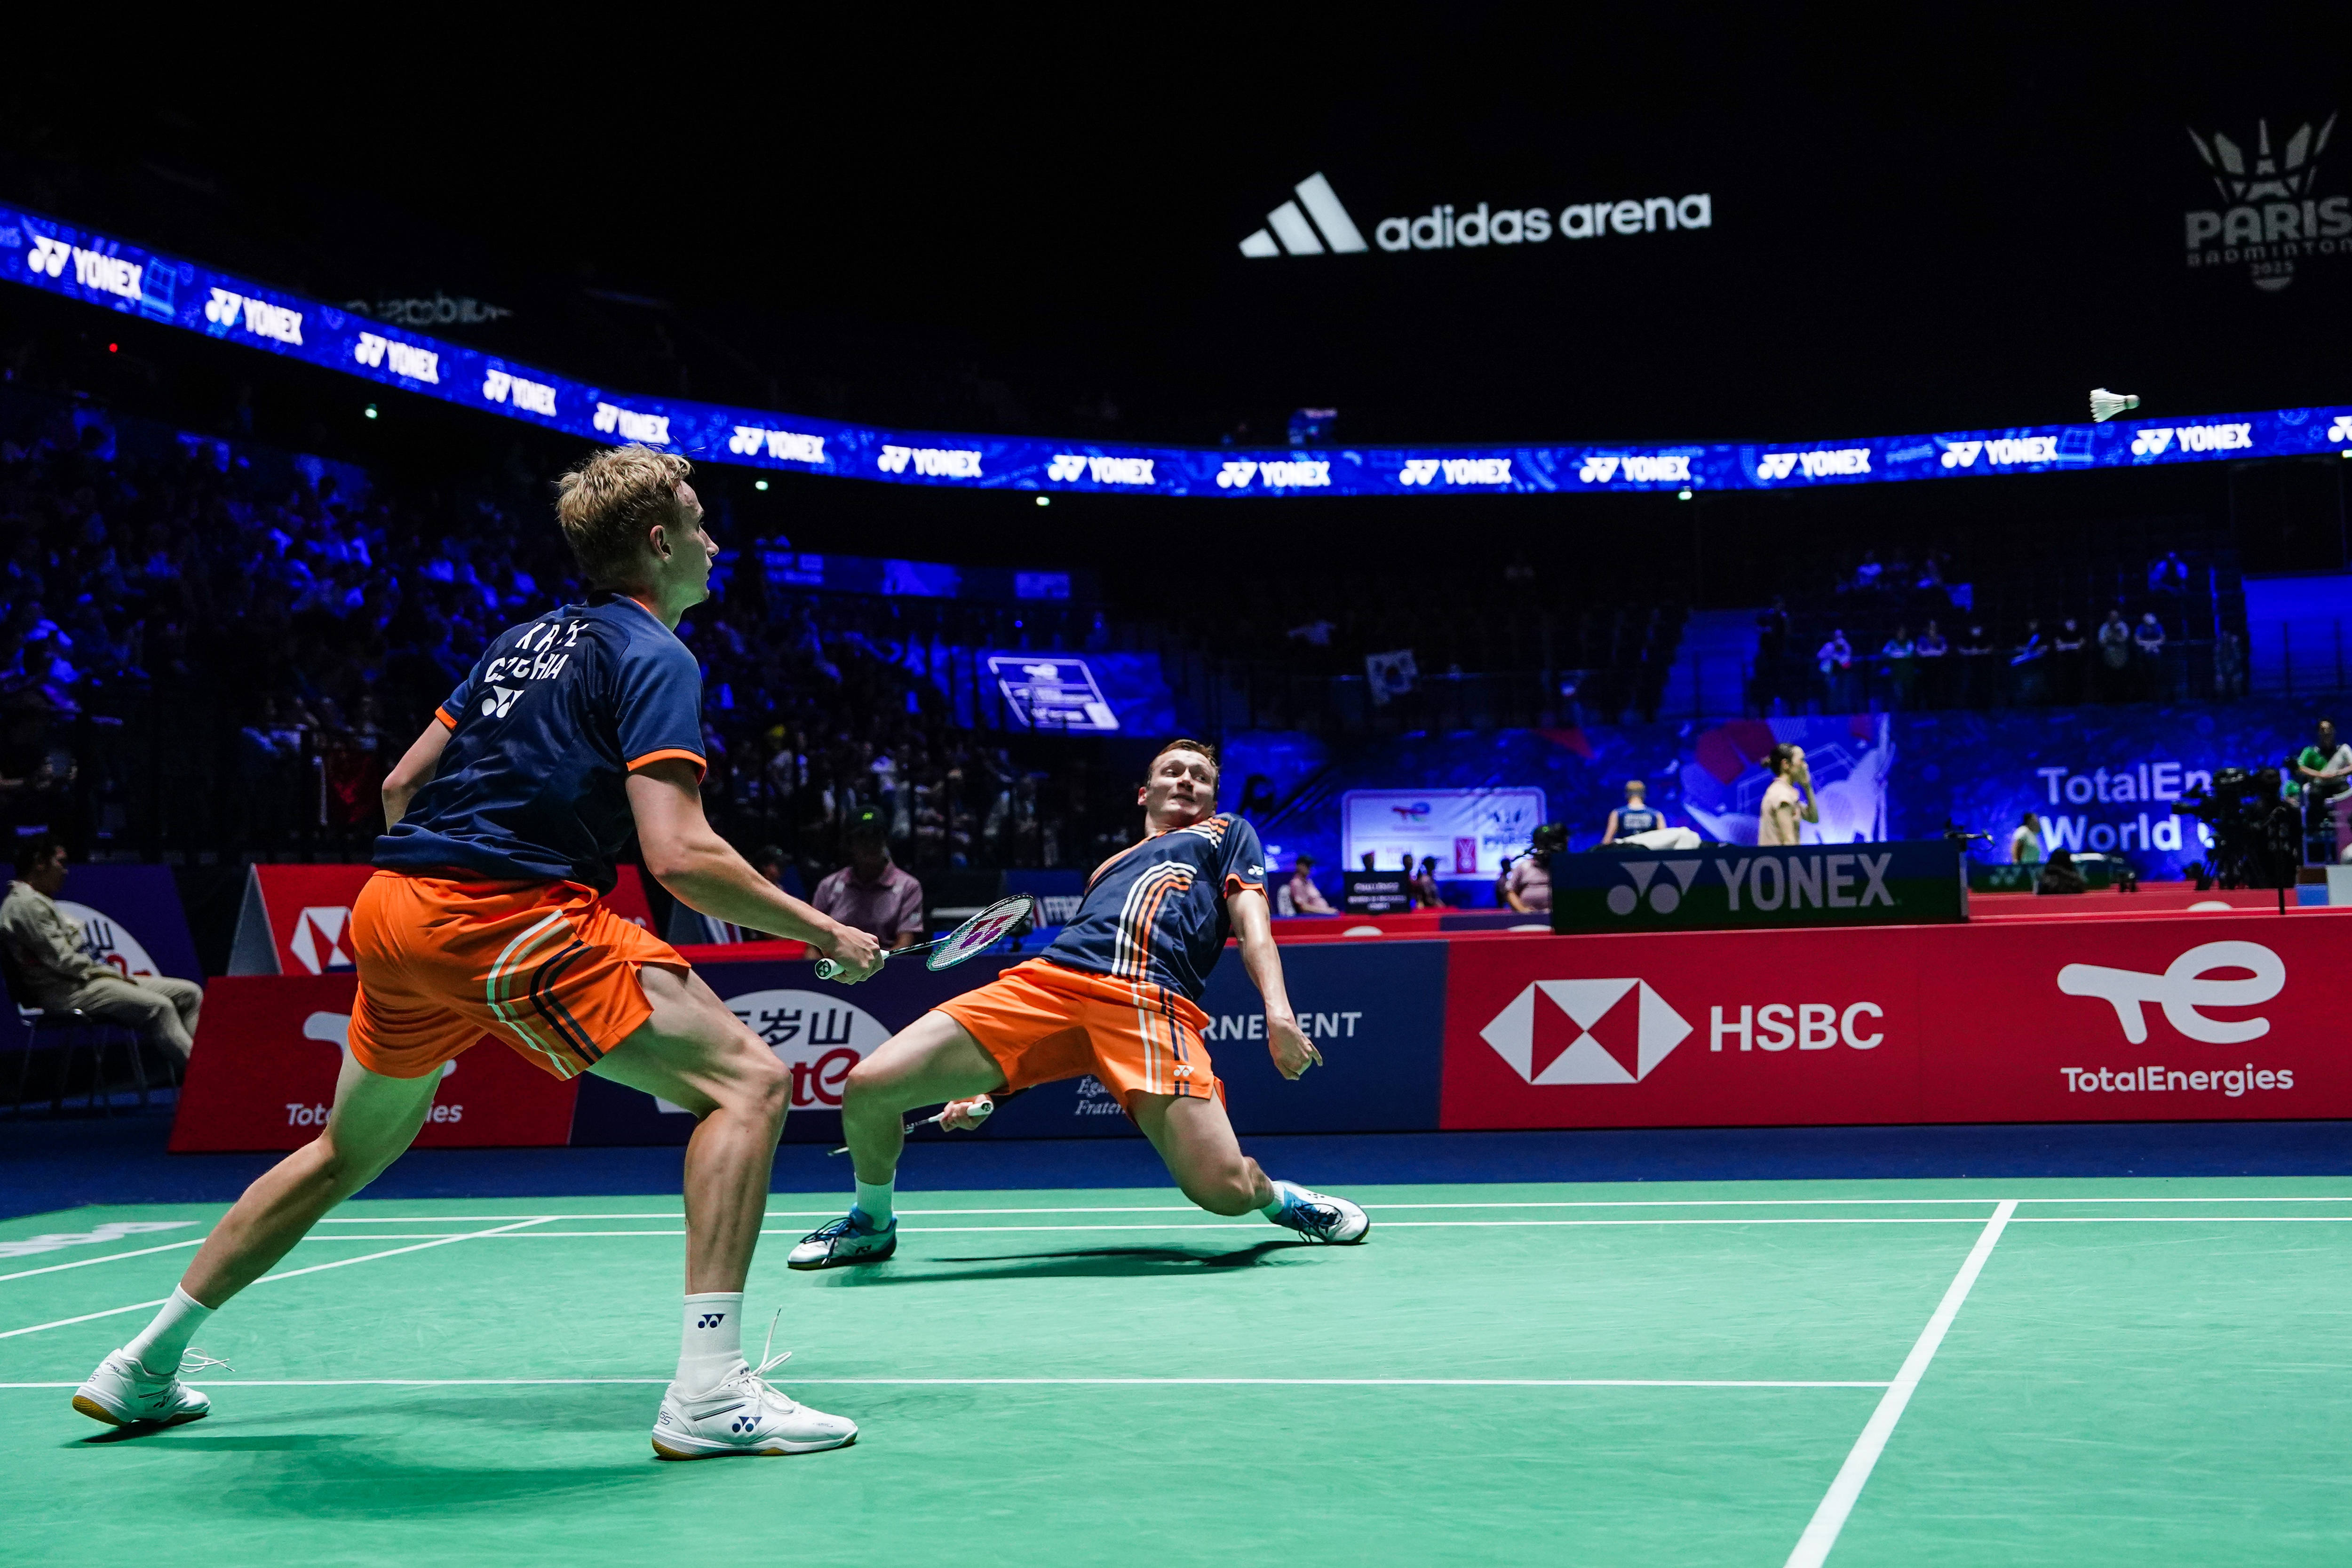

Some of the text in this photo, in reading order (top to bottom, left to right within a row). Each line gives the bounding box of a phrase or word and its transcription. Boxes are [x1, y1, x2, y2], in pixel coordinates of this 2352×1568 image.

[1375, 193, 1712, 252] adidas arena
[2185, 197, 2352, 249] PARIS
[72, 247, 143, 300] YONEX
[243, 296, 303, 345] YONEX
[386, 340, 439, 384] YONEX
[511, 376, 556, 416] YONEX
[618, 408, 670, 445] YONEX
[2176, 422, 2253, 452] YONEX
[765, 430, 826, 463] YONEX
[912, 448, 982, 478] YONEX
[1799, 448, 1871, 477] YONEX
[1984, 436, 2060, 465] YONEX
[1088, 456, 1155, 485] YONEX
[1259, 461, 1331, 487] YONEX
[1442, 458, 1512, 485] YONEX
[1621, 456, 1691, 482] YONEX
[2037, 762, 2213, 805] TotalEn
[2039, 812, 2183, 852] World
[1716, 853, 1895, 911] YONEX
[1710, 1002, 1884, 1052] HSBC
[2060, 1063, 2294, 1098] TotalEnergies
[1074, 1099, 1126, 1115] Frater
[659, 1411, 673, 1425] 65
